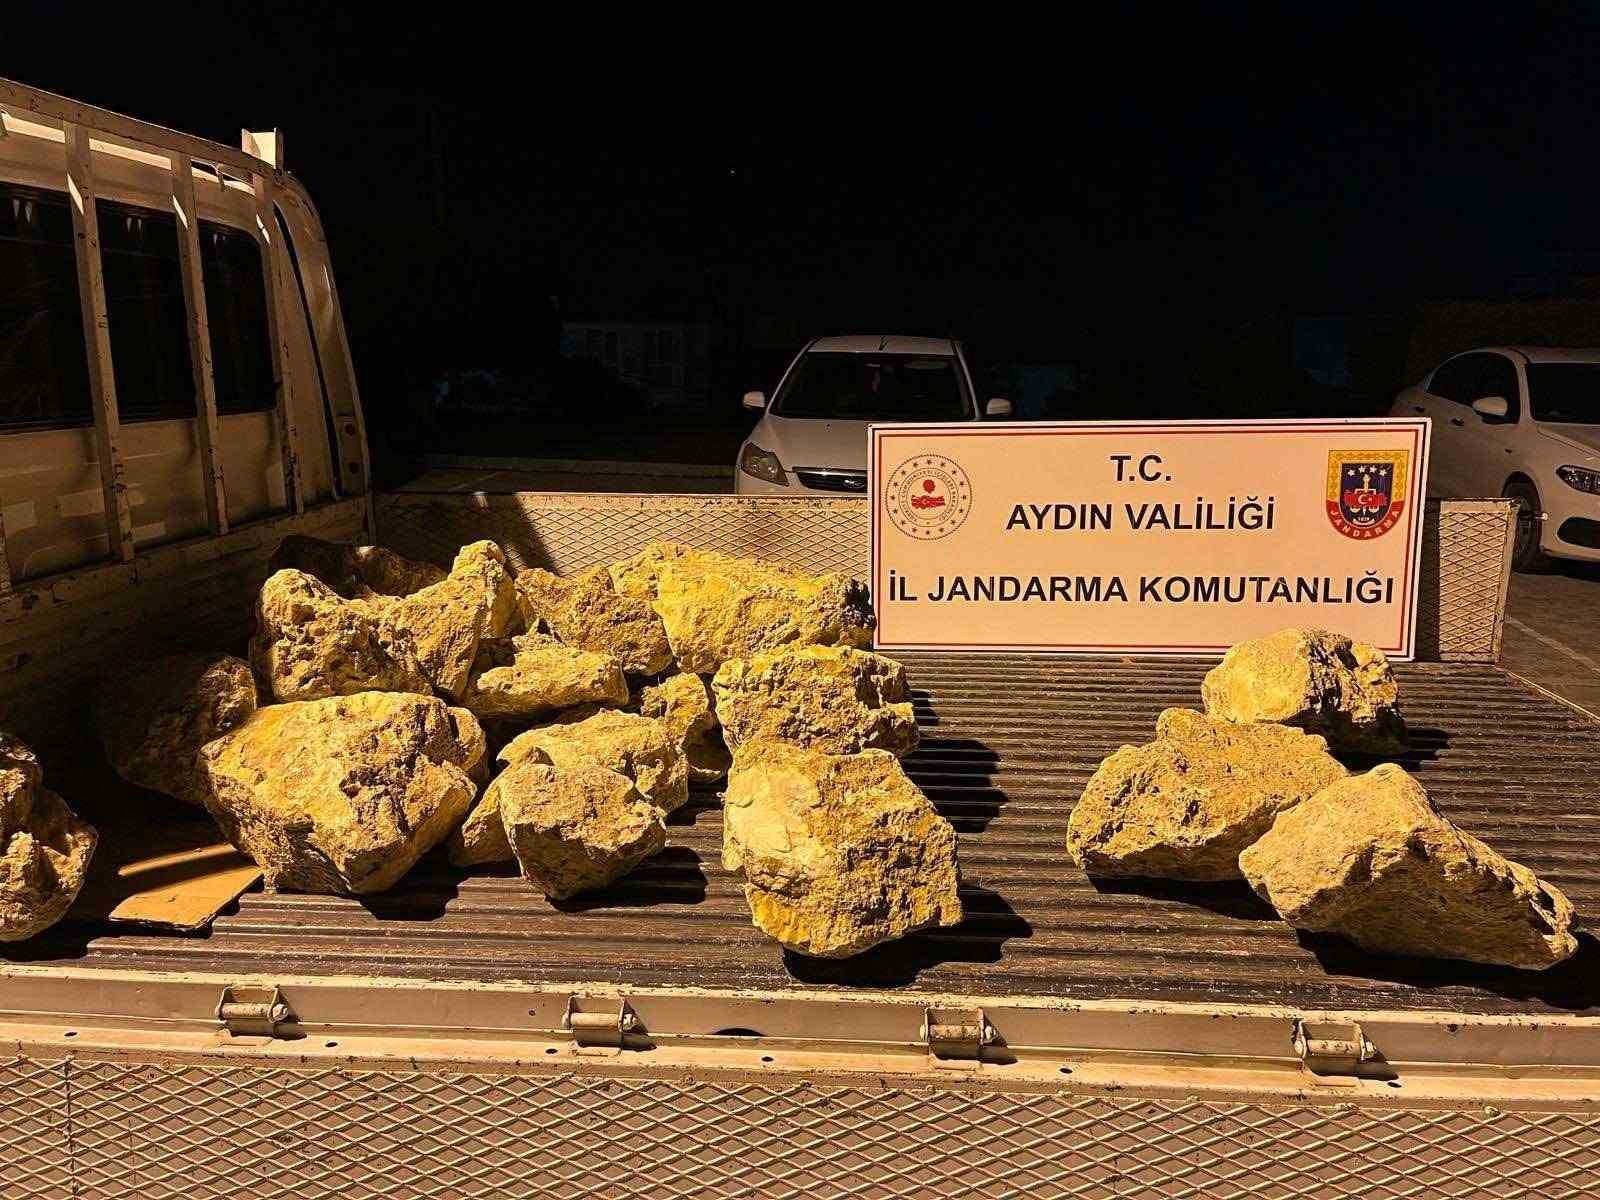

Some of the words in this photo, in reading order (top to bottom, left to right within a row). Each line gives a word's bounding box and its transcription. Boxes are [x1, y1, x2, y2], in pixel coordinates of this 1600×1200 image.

[1110, 455, 1172, 482] T.C.
[1006, 503, 1112, 530] AYDIN
[1125, 496, 1274, 530] VALİLİĞİ
[1330, 509, 1400, 538] JANDARMA
[889, 570, 918, 601] İL
[928, 576, 1128, 602] JANDARMA
[1139, 571, 1394, 604] KOMUTANLIĞI
